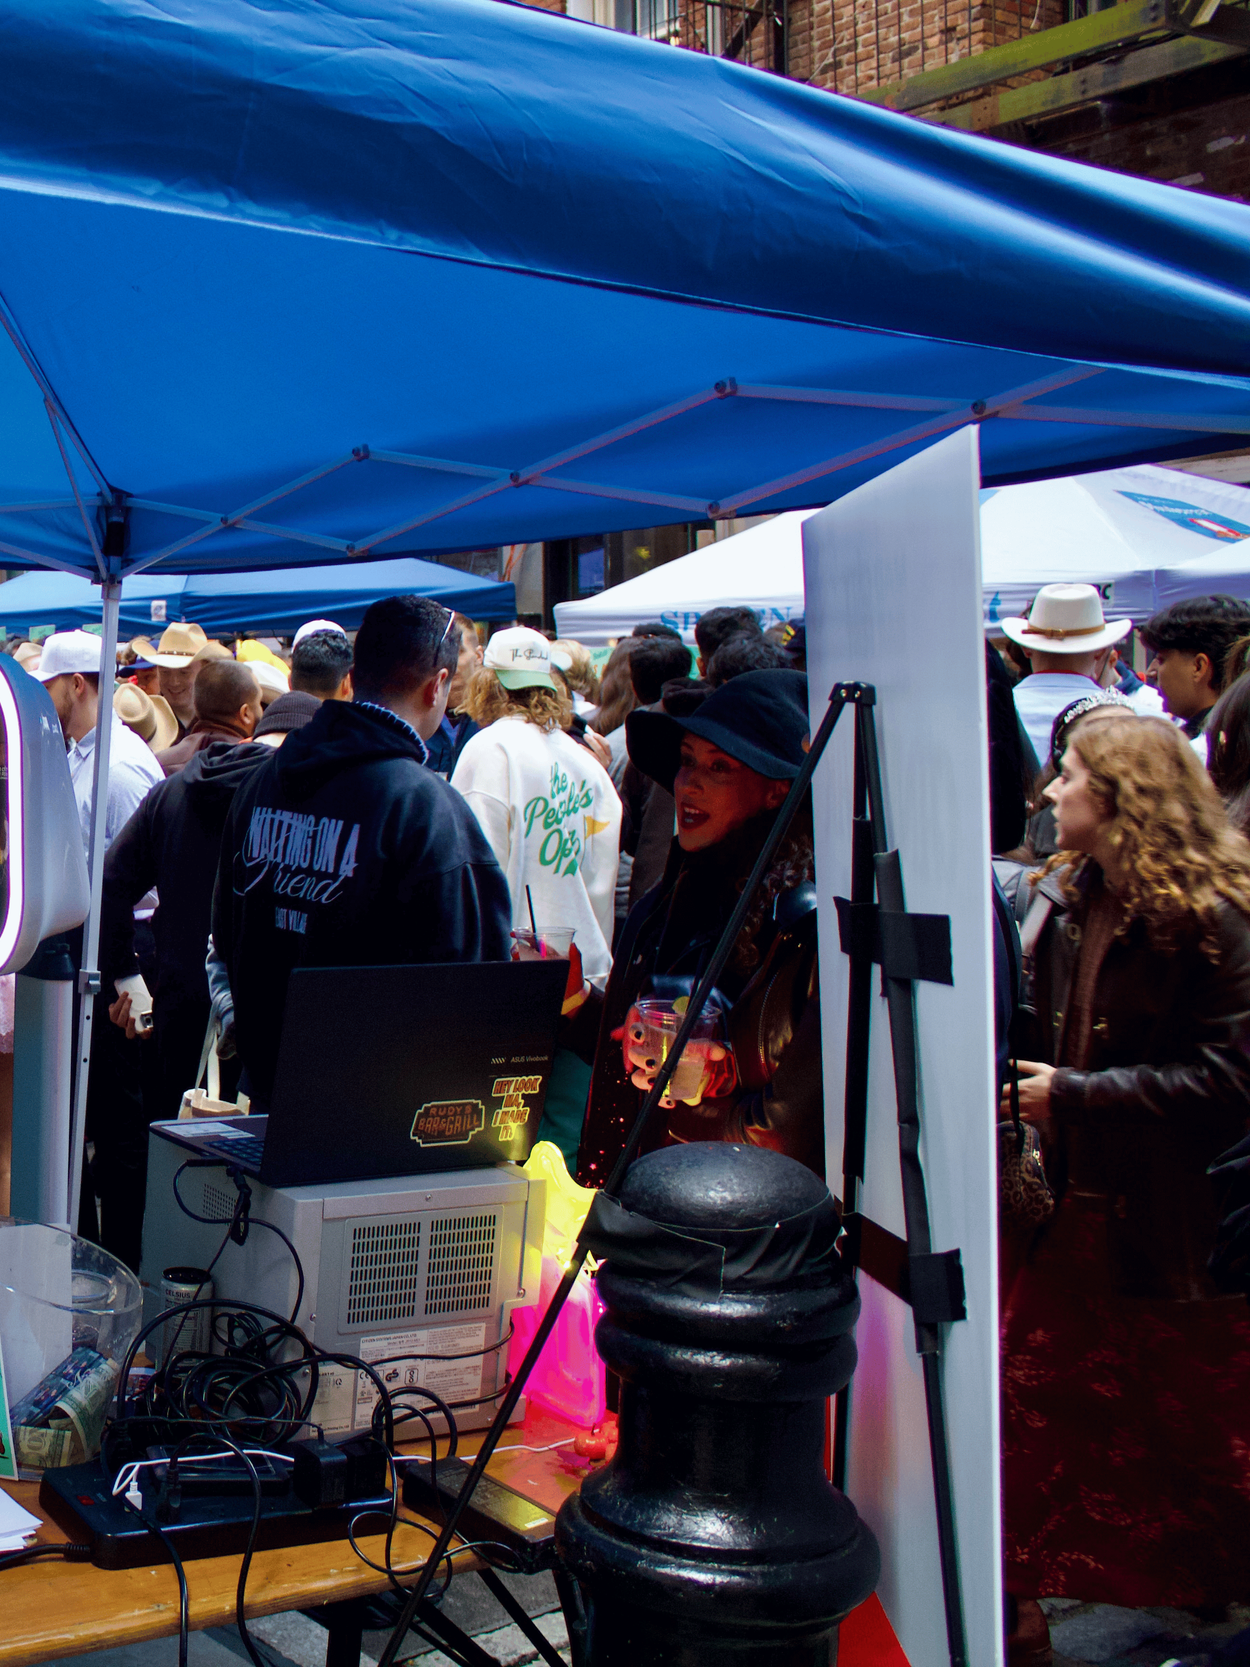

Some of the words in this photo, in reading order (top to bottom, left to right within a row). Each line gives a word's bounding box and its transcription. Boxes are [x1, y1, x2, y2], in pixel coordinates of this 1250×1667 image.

[549, 762, 568, 800] the
[313, 816, 344, 873] ON
[338, 823, 361, 877] A
[493, 1079, 515, 1095] HEY
[512, 1076, 541, 1093] LOOK
[500, 1108, 529, 1124] MADE
[165, 1288, 191, 1299] CELSIUS
